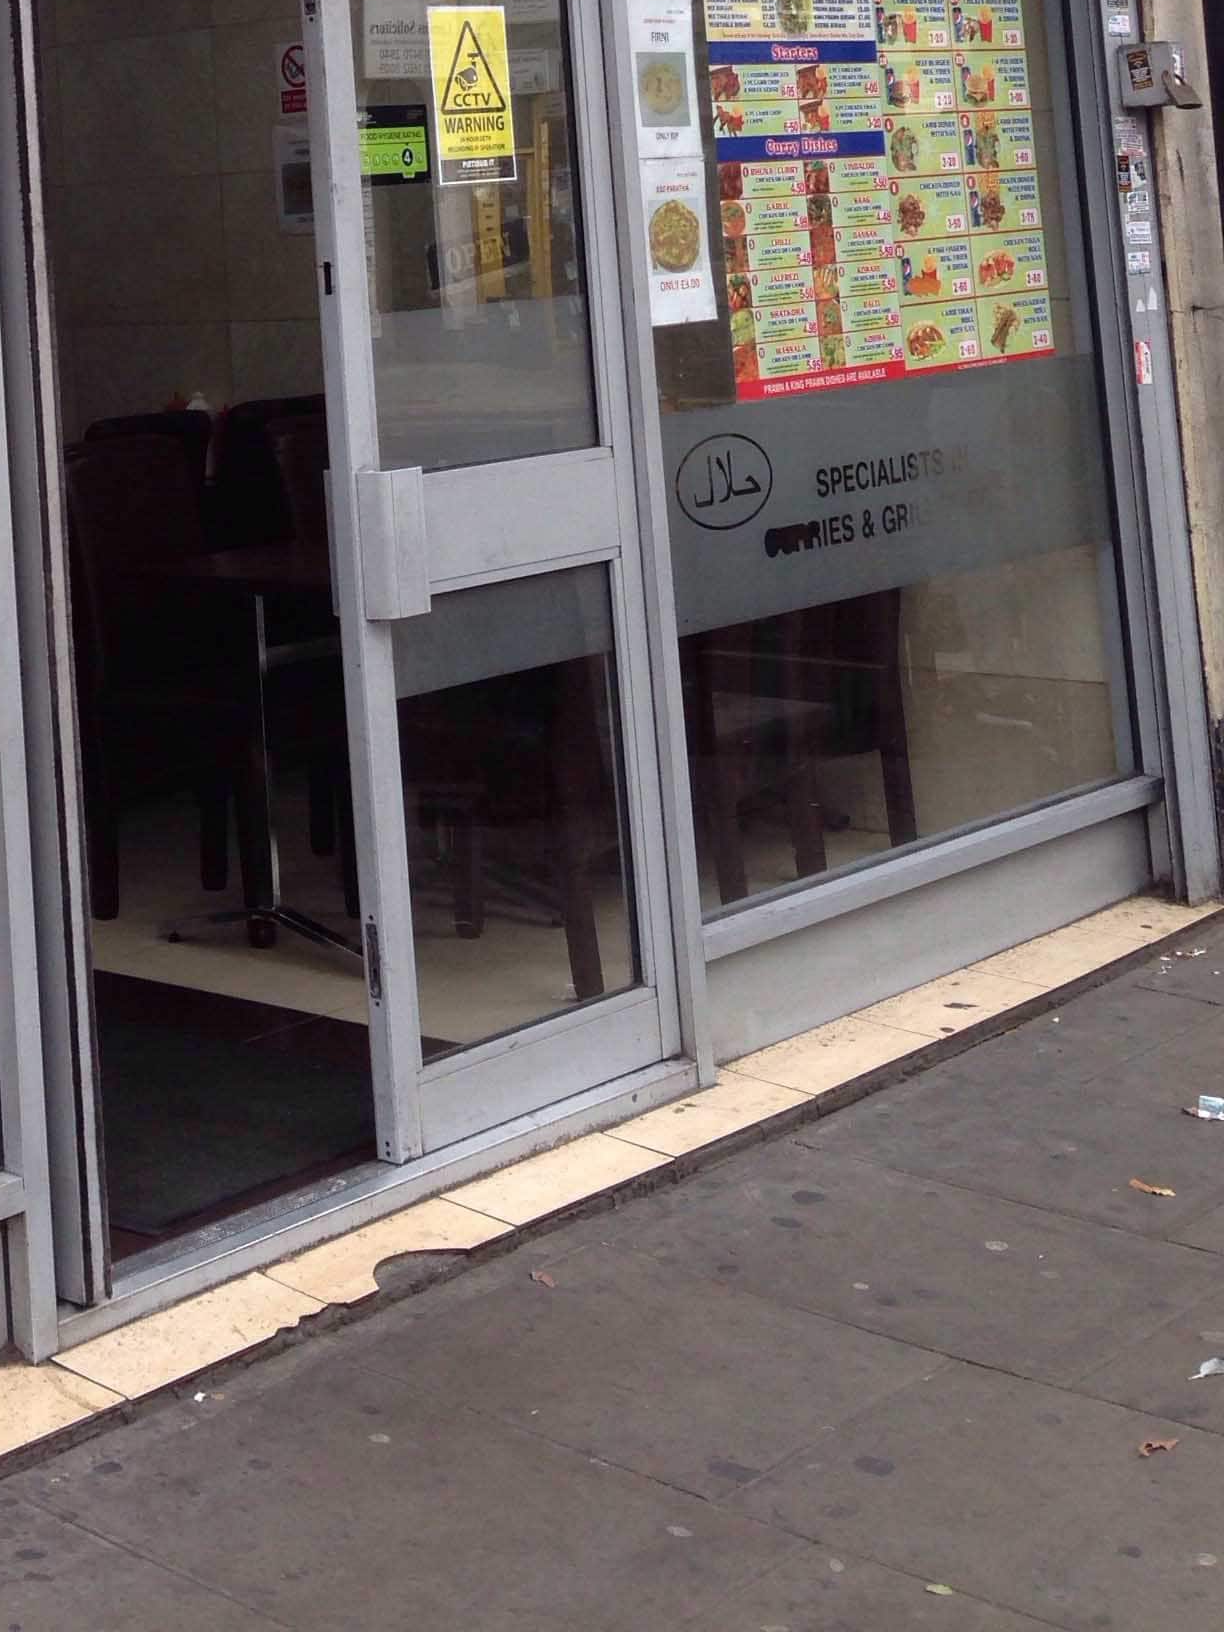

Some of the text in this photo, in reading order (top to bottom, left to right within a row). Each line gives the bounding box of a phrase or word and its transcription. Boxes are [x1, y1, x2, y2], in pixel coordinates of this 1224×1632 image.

[771, 45, 819, 61] Starters
[454, 93, 491, 108] CCTV
[445, 115, 505, 134] WARNING
[765, 136, 838, 157] Curry Dishes
[446, 231, 512, 273] OPEN
[816, 448, 944, 498] SPECIALISTS
[862, 509, 875, 538] &
